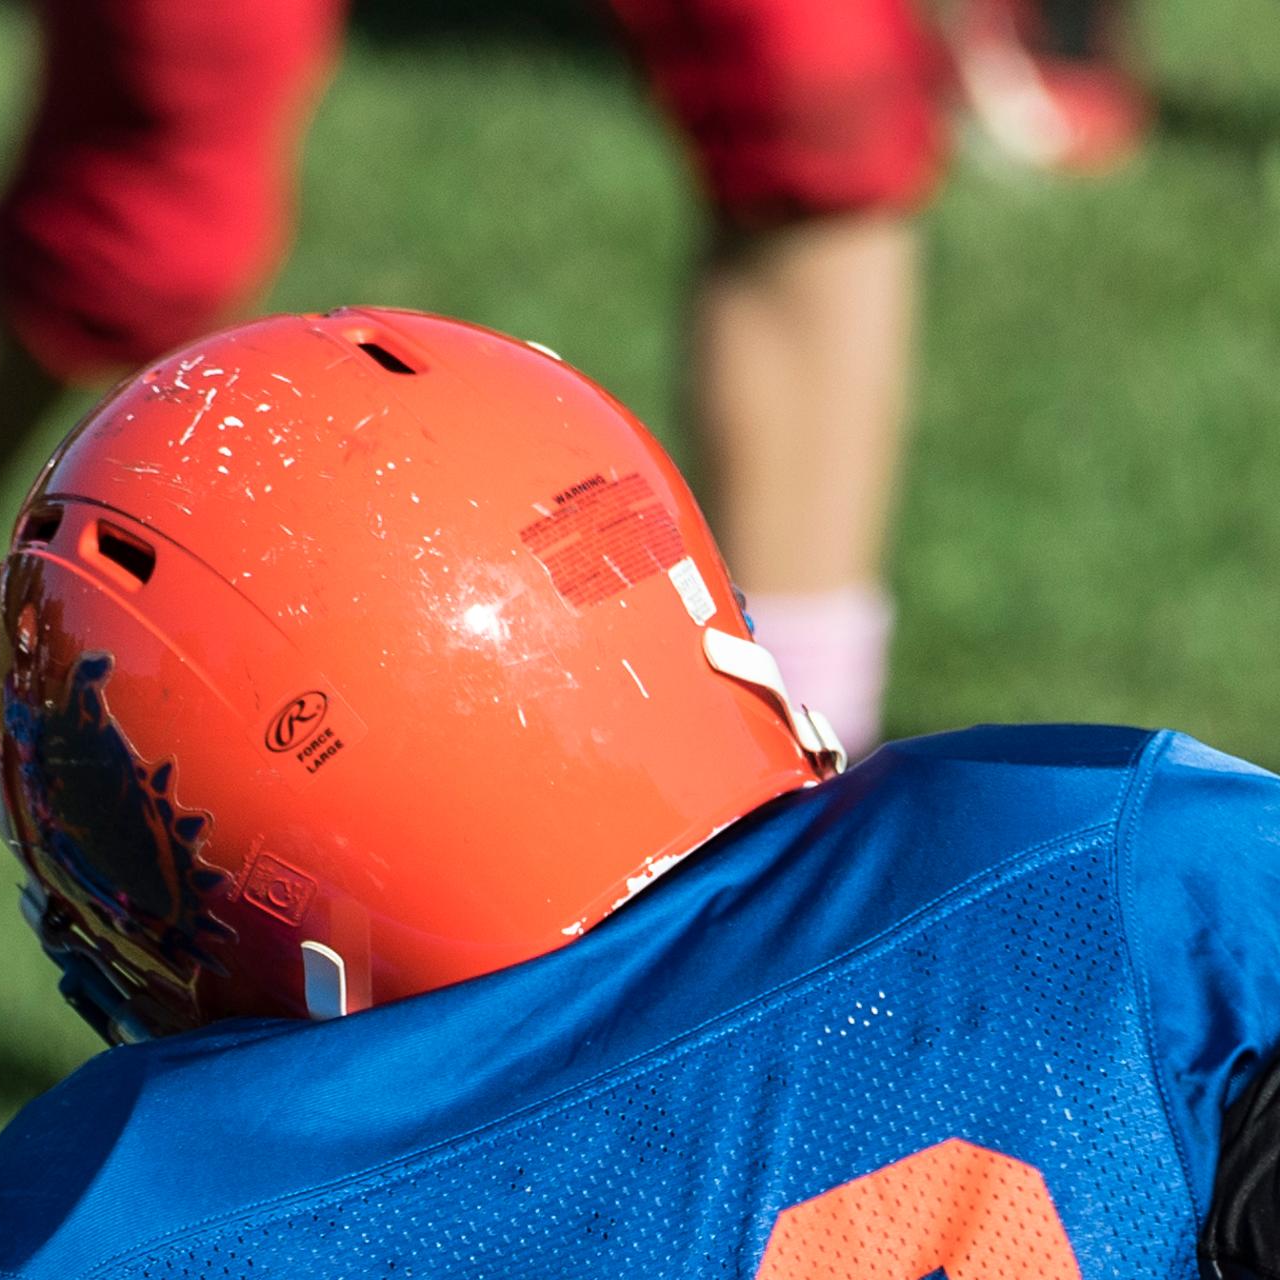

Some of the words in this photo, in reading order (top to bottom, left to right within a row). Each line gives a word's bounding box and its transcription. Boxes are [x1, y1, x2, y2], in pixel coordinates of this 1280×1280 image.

[553, 474, 606, 505] WARNING
[296, 727, 334, 762] FORCE
[306, 739, 344, 774] LARGE
